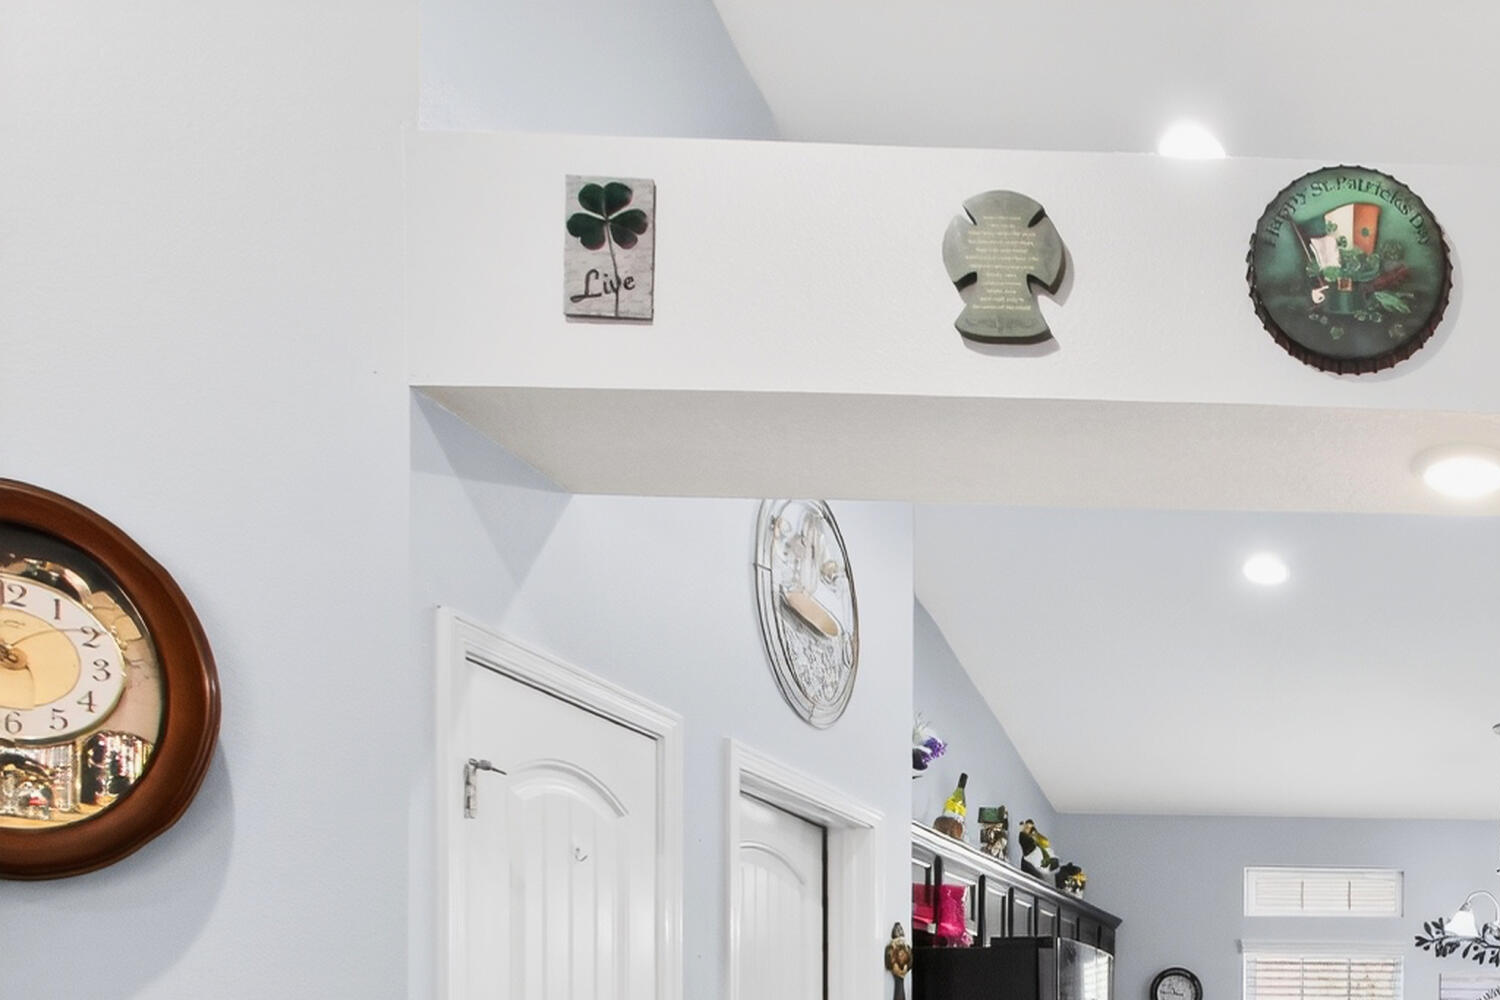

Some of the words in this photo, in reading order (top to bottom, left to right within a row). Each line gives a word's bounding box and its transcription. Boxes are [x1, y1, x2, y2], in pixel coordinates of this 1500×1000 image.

[569, 269, 636, 303] Live
[54, 598, 61, 620] 1
[80, 625, 100, 648] 2
[92, 659, 111, 682] 3
[77, 691, 96, 713] 4
[4, 712, 22, 734] 6
[49, 708, 68, 730] 5
